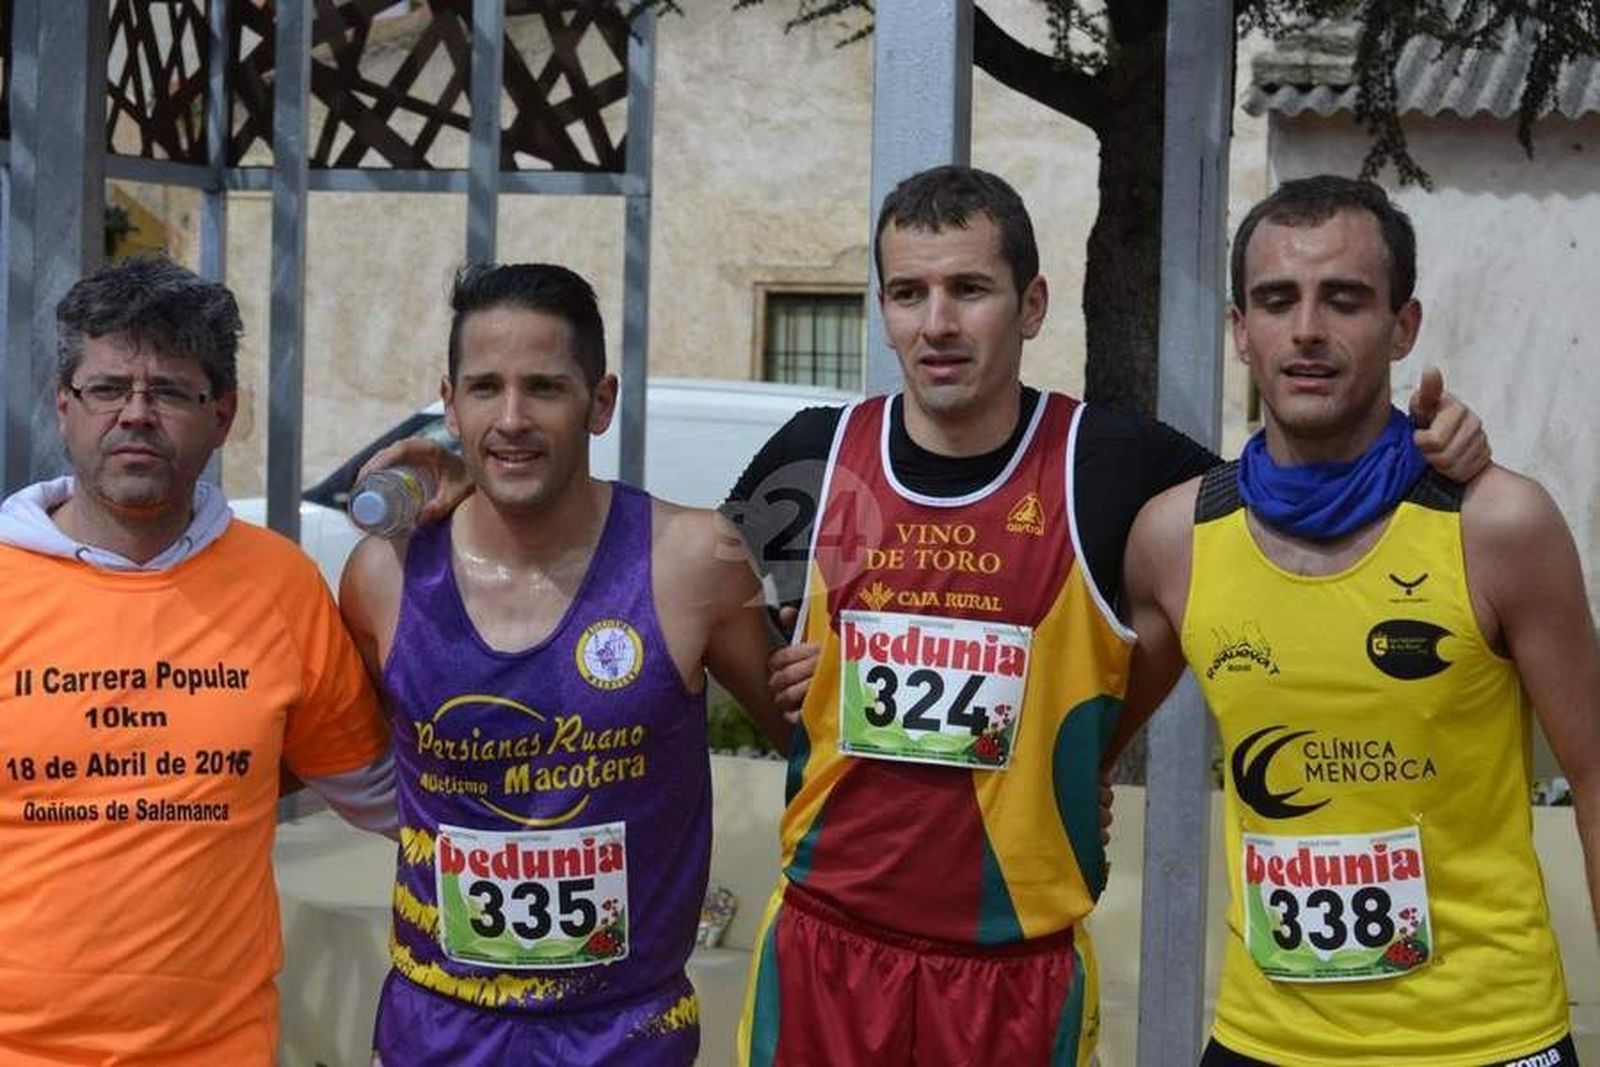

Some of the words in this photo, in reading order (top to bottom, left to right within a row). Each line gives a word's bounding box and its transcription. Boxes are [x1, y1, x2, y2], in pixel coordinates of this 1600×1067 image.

[897, 523, 976, 545] VINO
[867, 549, 903, 570] DE
[913, 549, 1001, 574] TORO
[898, 591, 939, 606] CAJA
[945, 593, 1003, 611] RURAL
[845, 622, 1026, 677] bedunia
[15, 669, 32, 696] II
[43, 667, 146, 694] Carrera
[156, 661, 250, 694] Popular
[85, 706, 167, 728] 10km
[865, 665, 989, 736] 324
[414, 722, 541, 761] Persianas
[547, 714, 645, 755] Ruano
[1303, 738, 1396, 760] CLÍNICA
[7, 757, 36, 781] 18
[45, 756, 77, 779] de
[86, 753, 146, 777] Abril
[156, 752, 186, 775] de
[504, 753, 646, 794] Macotera
[1306, 759, 1437, 782] MENORCA
[105, 800, 129, 821] de
[135, 799, 229, 822] Salamanca
[440, 836, 624, 880] bedunia
[1246, 844, 1421, 887] bedunia
[469, 878, 598, 940] 335
[1270, 886, 1395, 950] 338
